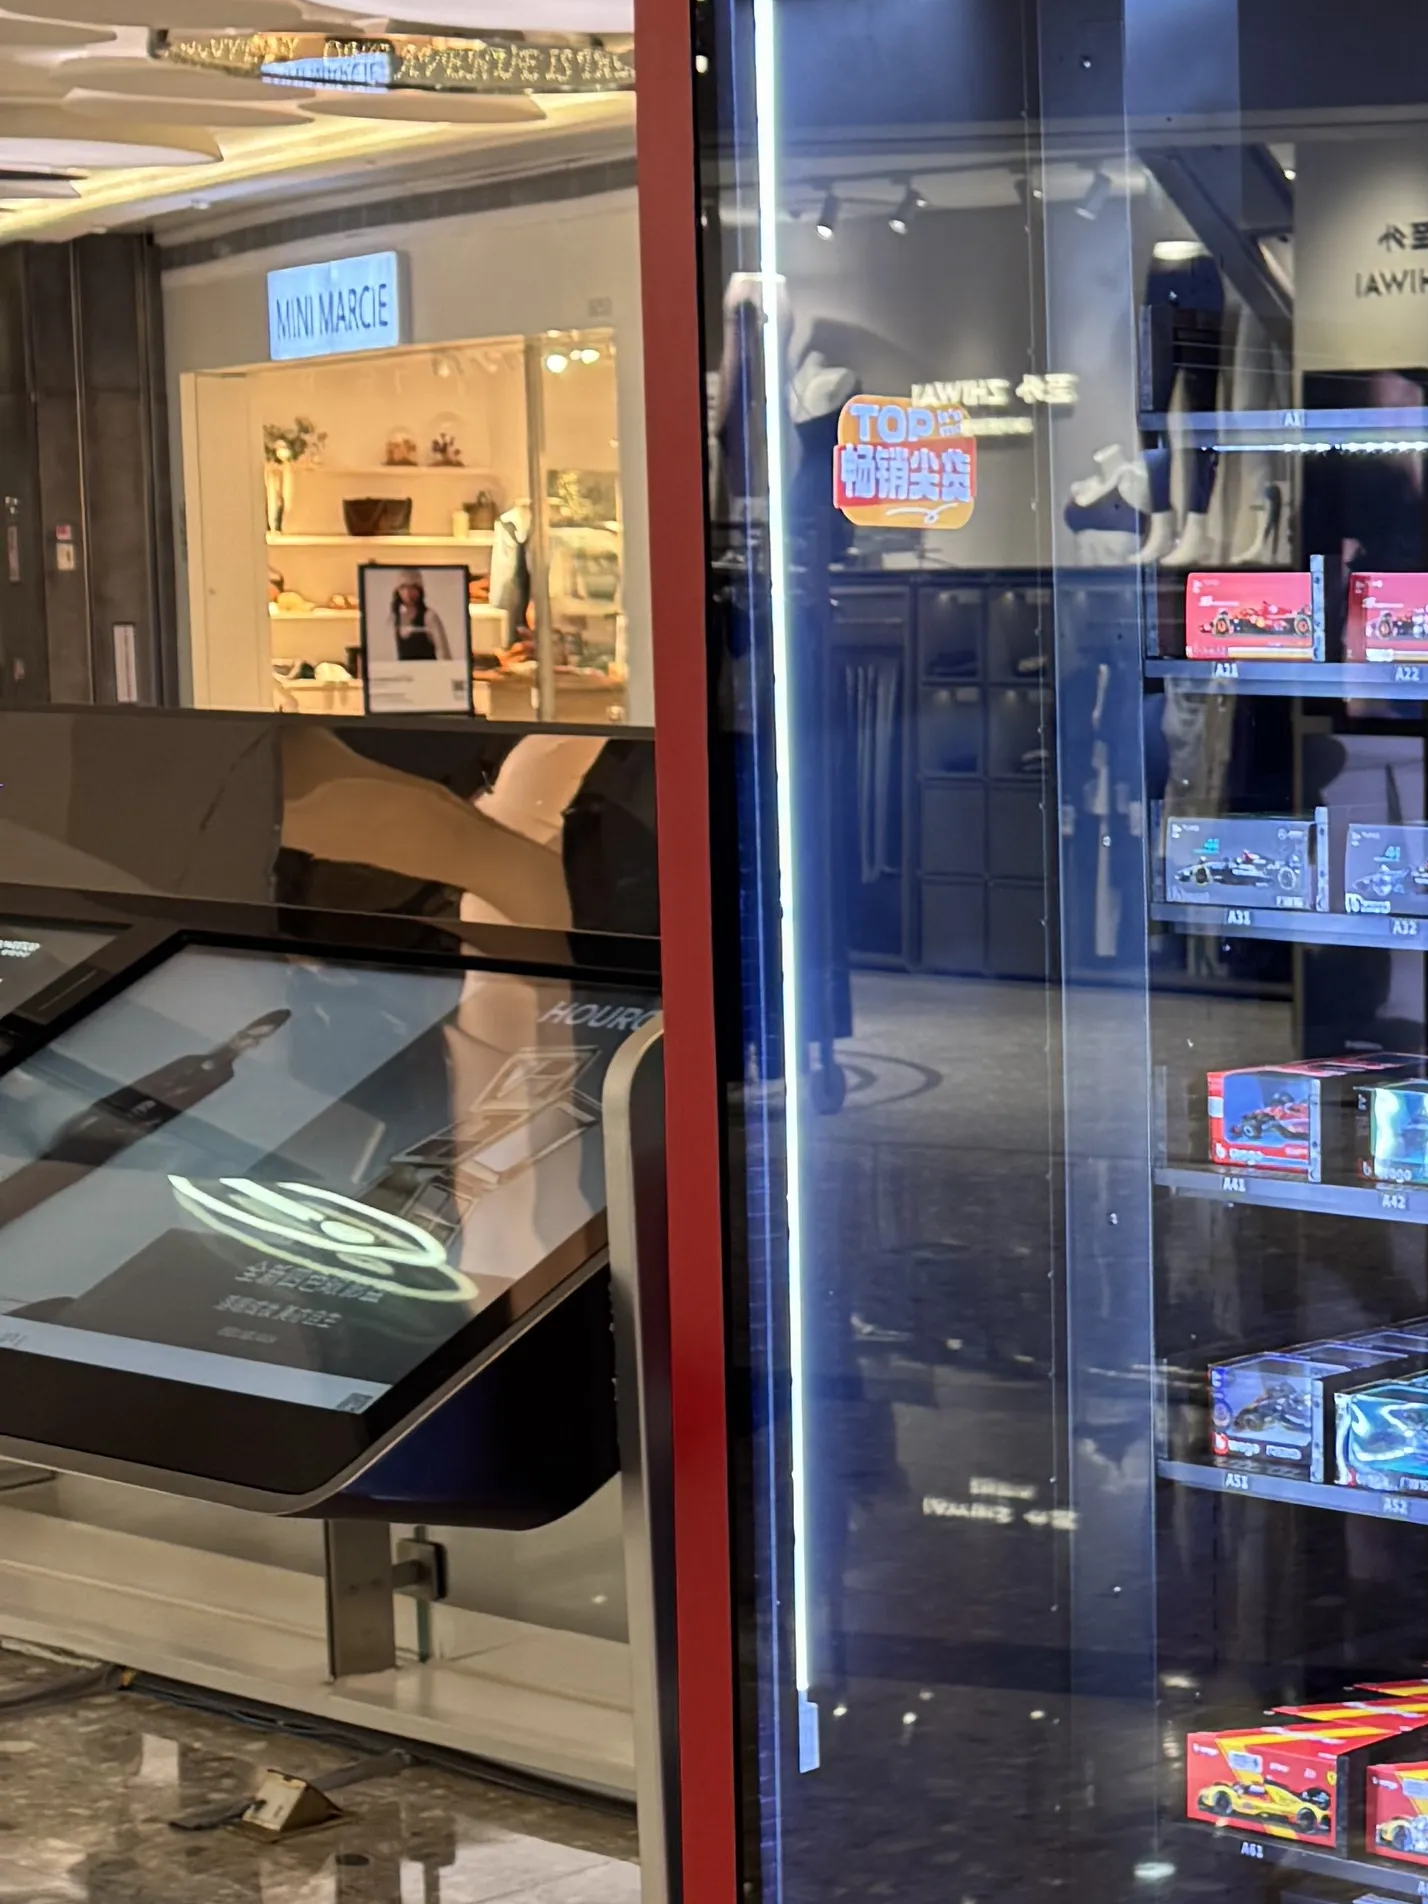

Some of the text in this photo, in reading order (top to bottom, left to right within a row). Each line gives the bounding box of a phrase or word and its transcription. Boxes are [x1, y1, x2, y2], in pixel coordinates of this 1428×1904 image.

[275, 282, 390, 344] MINI MARCIE
[849, 403, 935, 443] TOP
[1394, 666, 1421, 682] A22
[1222, 1176, 1247, 1193] A41
[1381, 1193, 1407, 1210] A42
